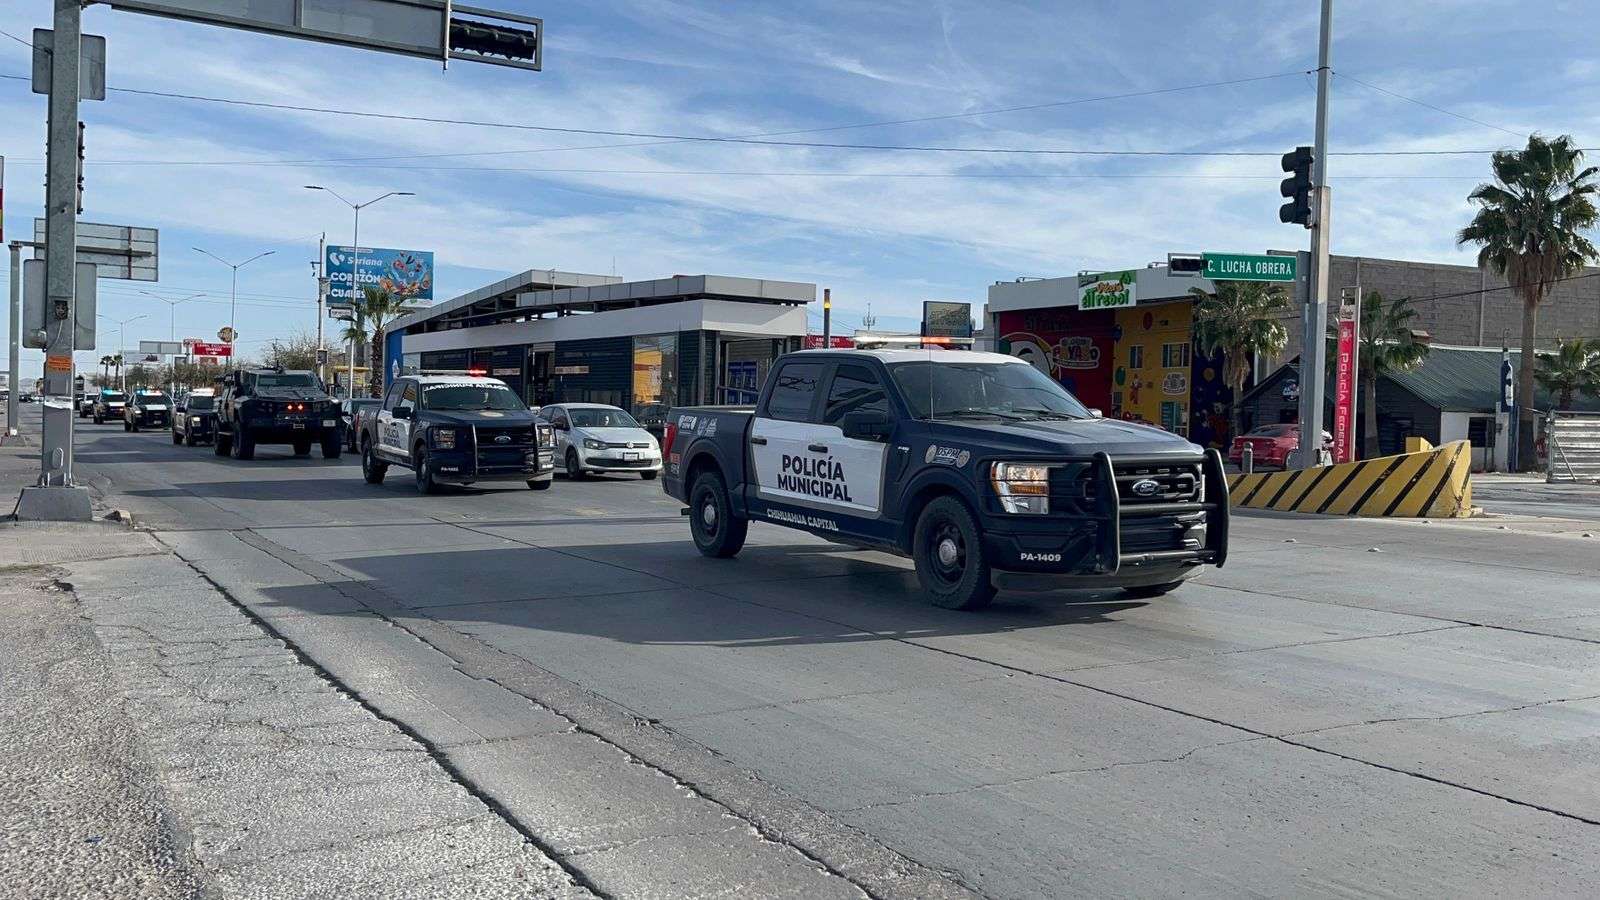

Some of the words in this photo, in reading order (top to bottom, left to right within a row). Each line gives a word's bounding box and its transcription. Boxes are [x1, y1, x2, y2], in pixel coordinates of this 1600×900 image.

[1207, 259, 1216, 272] C.
[1221, 260, 1252, 274] LUCHA
[1255, 262, 1292, 275] OBRERA
[782, 454, 845, 482] POLICÍA
[777, 473, 853, 503] MUNICIPAL
[766, 508, 807, 525] CHIHUAHUA
[807, 516, 840, 532] CAPITAL
[1020, 552, 1062, 562] PA-1409
